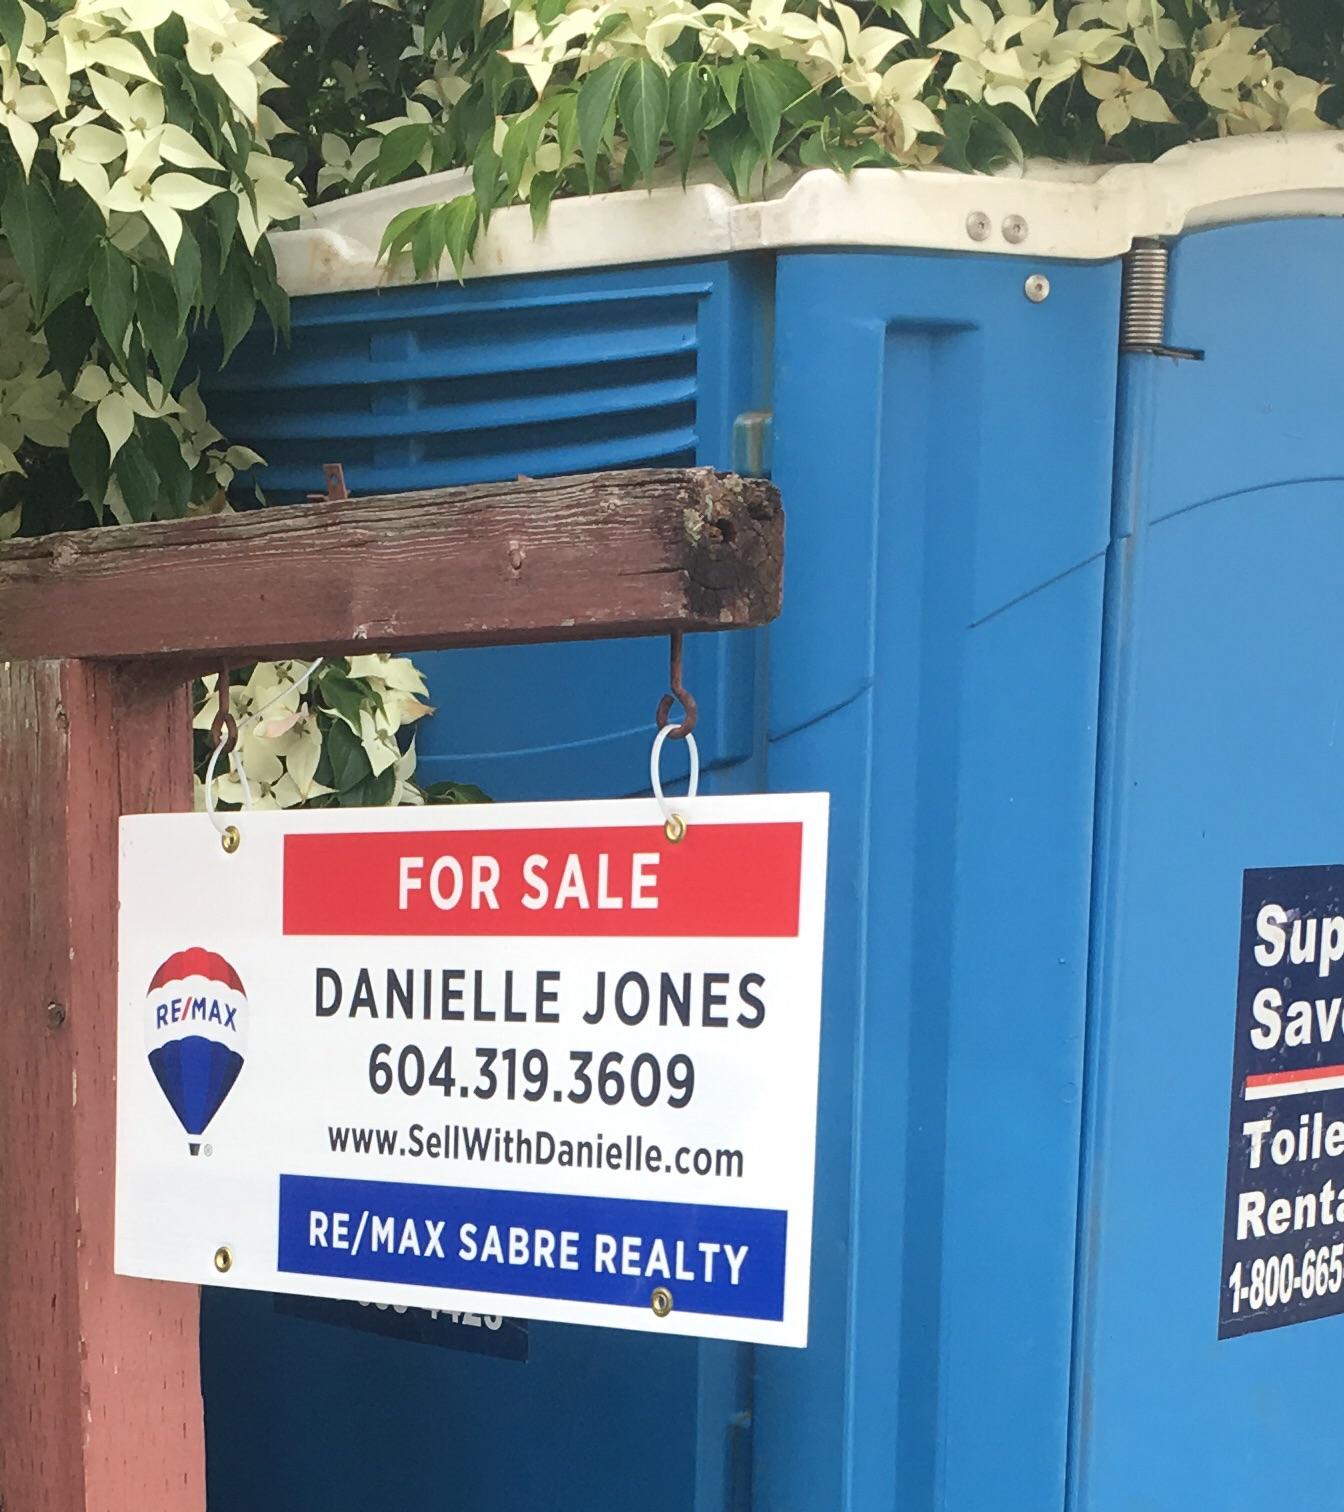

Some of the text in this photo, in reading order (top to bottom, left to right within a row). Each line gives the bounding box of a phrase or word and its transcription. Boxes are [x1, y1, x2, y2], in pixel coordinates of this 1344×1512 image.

[397, 852, 660, 911] FOR SALE
[156, 996, 237, 1032] RE/MAX
[314, 967, 767, 1030] DANIELLE JONES
[368, 1043, 696, 1109] 604.319.3609
[327, 1123, 745, 1178] www.SellWithDanielle.com
[308, 1209, 749, 1285] RE/MAX SABRE REALTY
